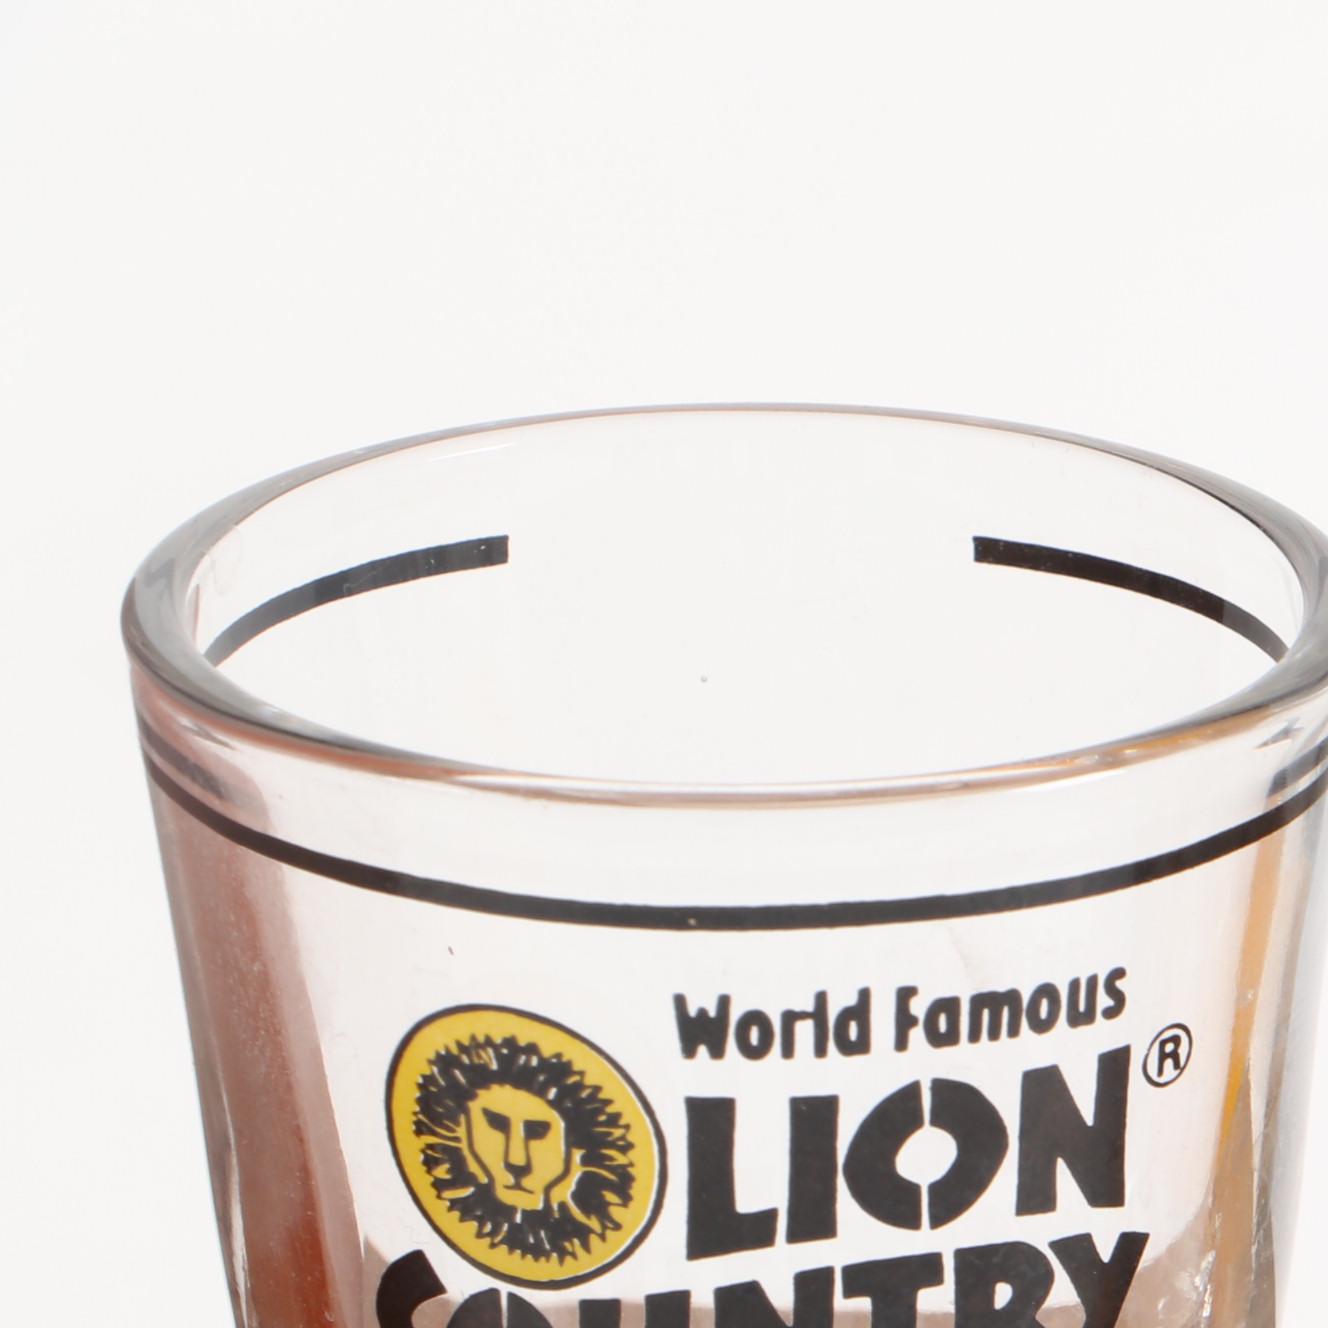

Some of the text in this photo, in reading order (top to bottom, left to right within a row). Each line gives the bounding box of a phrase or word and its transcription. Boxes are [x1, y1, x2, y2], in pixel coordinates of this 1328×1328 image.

[673, 966, 1127, 1061] World Famous
[684, 1044, 1132, 1261] LION
